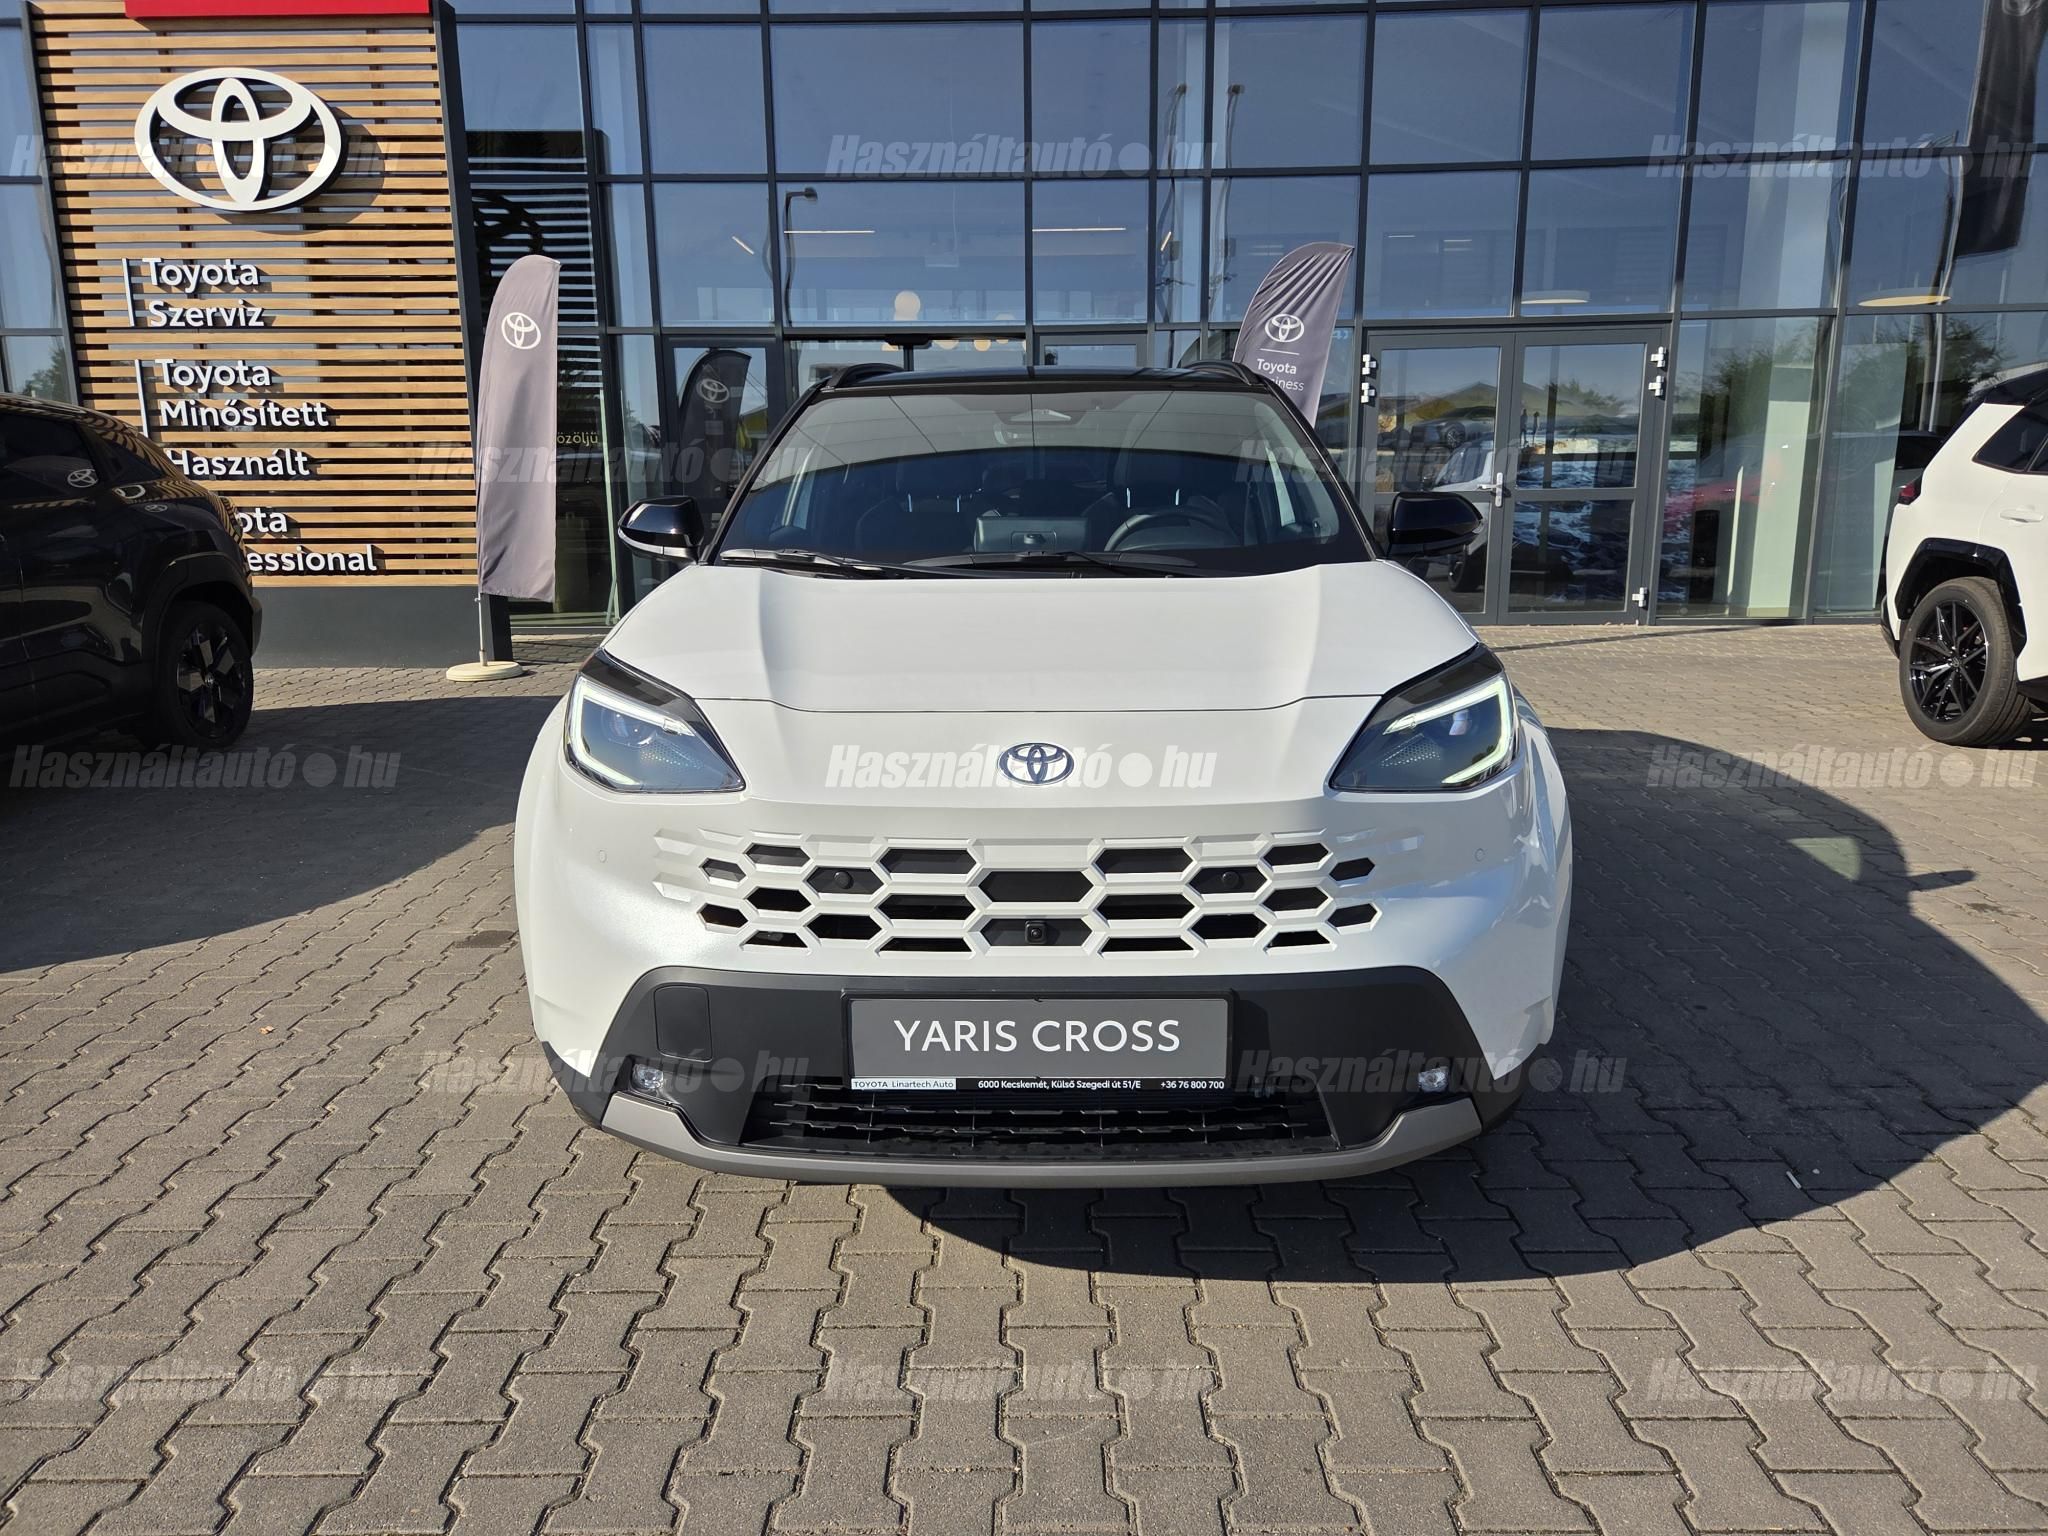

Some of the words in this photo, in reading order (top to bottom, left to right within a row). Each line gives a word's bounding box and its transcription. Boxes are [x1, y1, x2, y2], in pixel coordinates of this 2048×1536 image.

[142, 258, 259, 293] Toyota
[149, 299, 264, 327] Szerviz
[155, 359, 271, 393] Toyota
[1257, 359, 1297, 374] Toyota
[160, 399, 329, 427] Minősített
[166, 448, 310, 476] Használt
[235, 507, 288, 533] ota
[247, 544, 377, 571] essional
[893, 1020, 1018, 1052] YARIS
[1032, 1020, 1181, 1053] CROSS
[892, 1080, 931, 1088] Linartech
[933, 1080, 954, 1088] Auto
[978, 1080, 1000, 1089] 6000
[1001, 1079, 1050, 1090] Kecskemét,
[1051, 1079, 1075, 1089] Külső
[1077, 1080, 1110, 1091] Szegedi
[1112, 1080, 1121, 1089] út
[1122, 1080, 1141, 1090] 51/E
[1160, 1080, 1176, 1089] +36
[1178, 1080, 1189, 1089] 76
[1190, 1080, 1207, 1089] 800
[1208, 1080, 1225, 1089] 700
